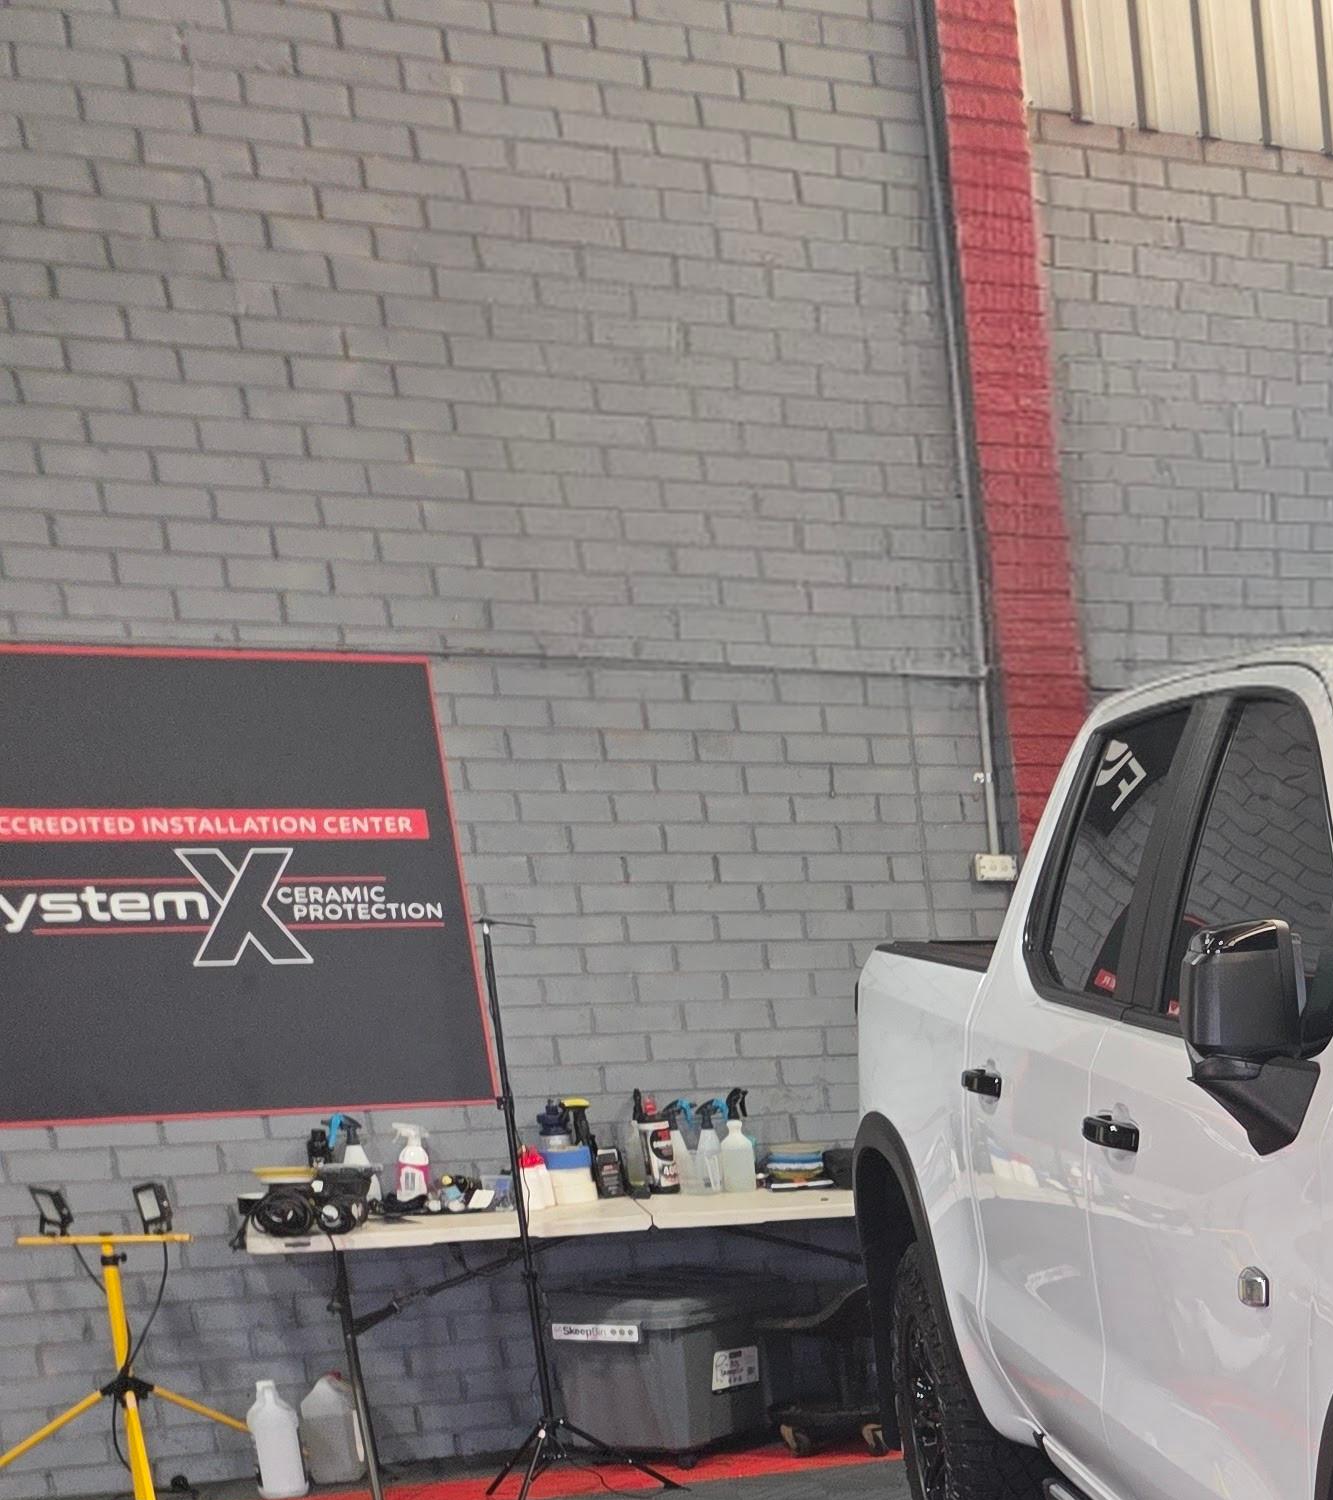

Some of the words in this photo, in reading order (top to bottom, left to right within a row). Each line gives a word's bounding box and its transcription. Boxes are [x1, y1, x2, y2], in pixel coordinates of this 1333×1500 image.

[143, 816, 317, 835] INSTALLATION
[323, 816, 413, 833] CENTER
[277, 886, 386, 904] CERAMIC
[293, 902, 443, 921] PROTECTION
